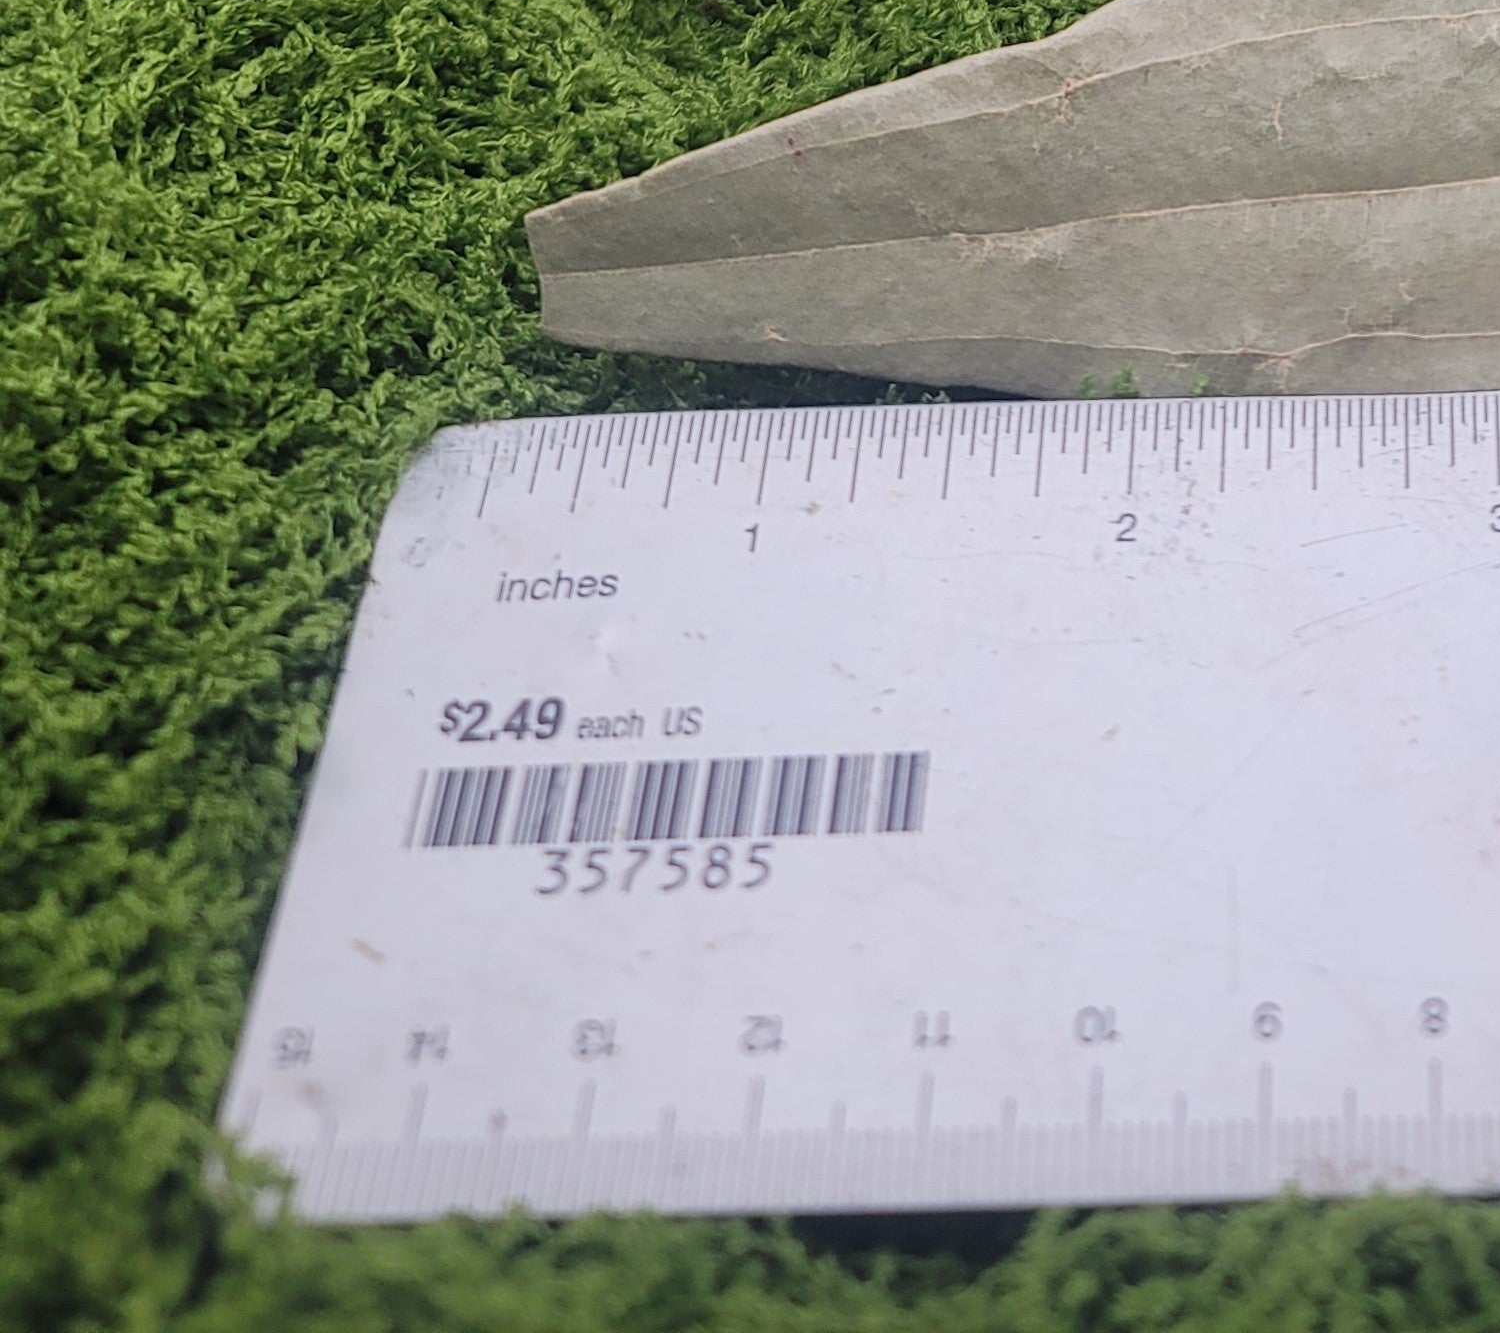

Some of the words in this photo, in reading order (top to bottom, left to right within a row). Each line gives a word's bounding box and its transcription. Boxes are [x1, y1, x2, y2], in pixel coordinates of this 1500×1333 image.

[743, 522, 759, 554] 1
[1110, 511, 1138, 543] 2
[495, 570, 620, 602] inches
[438, 696, 565, 744] $2.49
[575, 708, 645, 740] each
[661, 705, 704, 737] US
[534, 843, 775, 896] 357585
[740, 1014, 785, 1053] 12
[913, 1011, 952, 1048] 11
[1074, 1005, 1118, 1044] 10
[1252, 1000, 1281, 1040] 9
[1420, 995, 1448, 1035] 8
